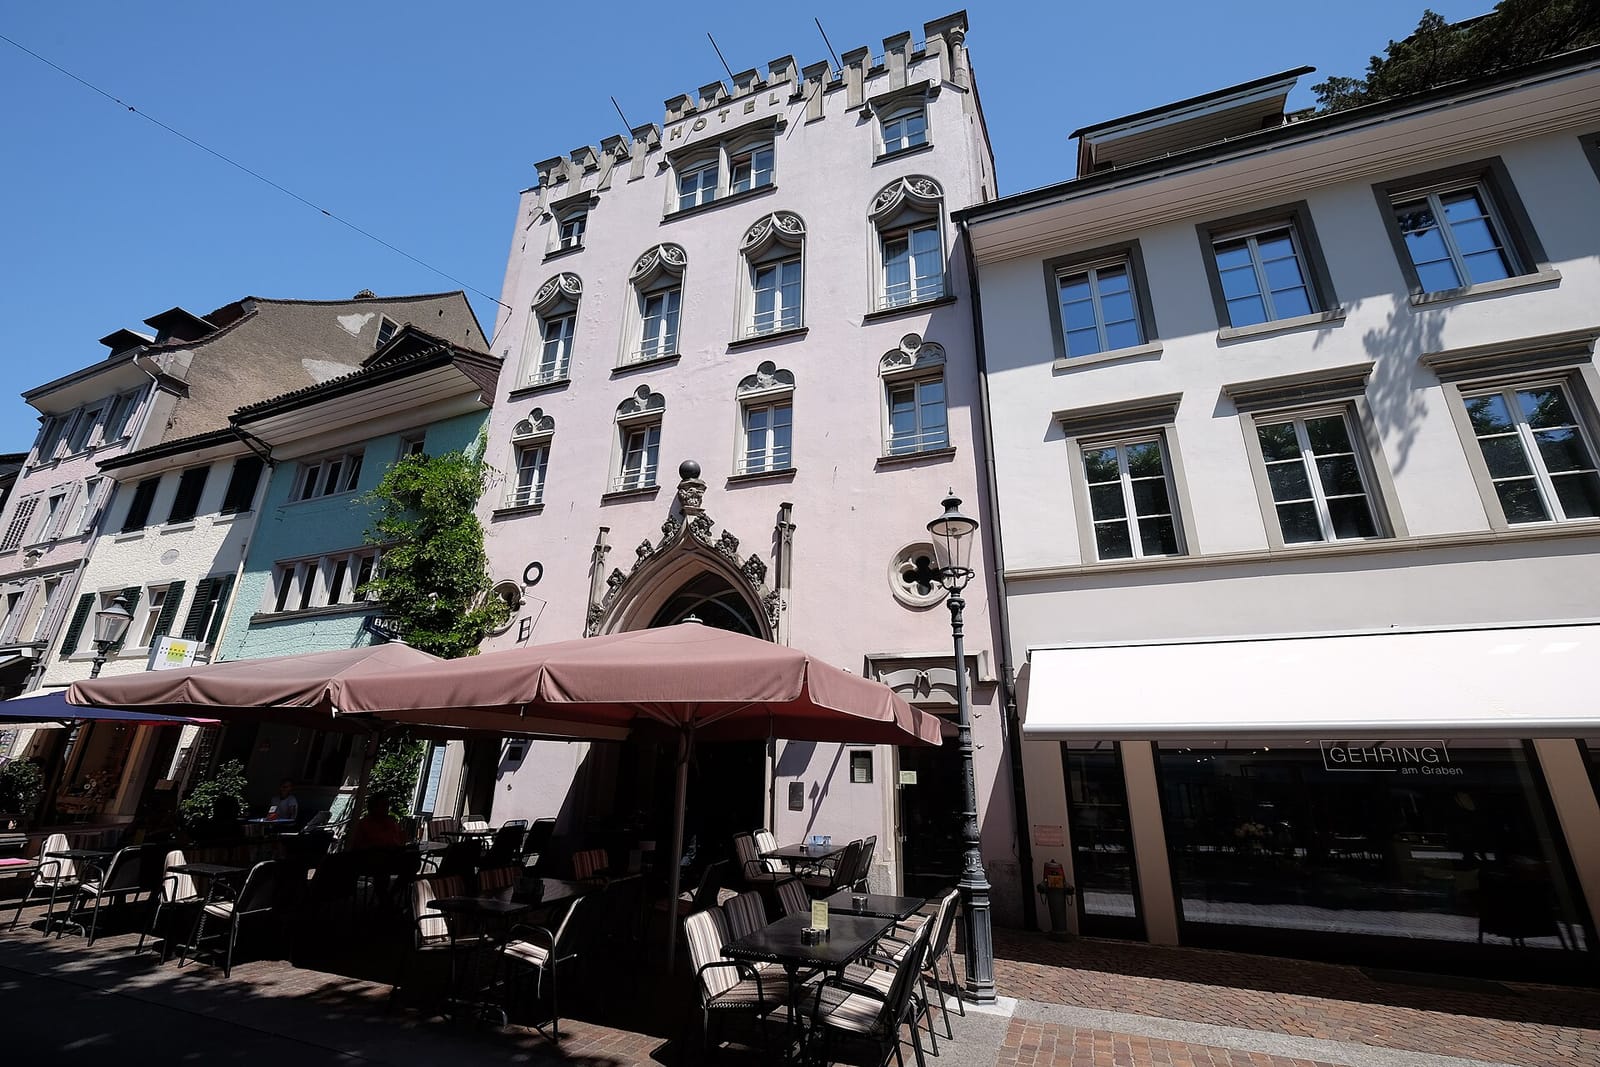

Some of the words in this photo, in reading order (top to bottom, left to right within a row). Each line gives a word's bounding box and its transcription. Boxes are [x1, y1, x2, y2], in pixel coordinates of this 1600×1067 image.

[670, 92, 780, 141] HOTEL
[1330, 747, 1439, 763] GEHRING
[1401, 767, 1418, 775] am
[1421, 766, 1463, 775] Graben
